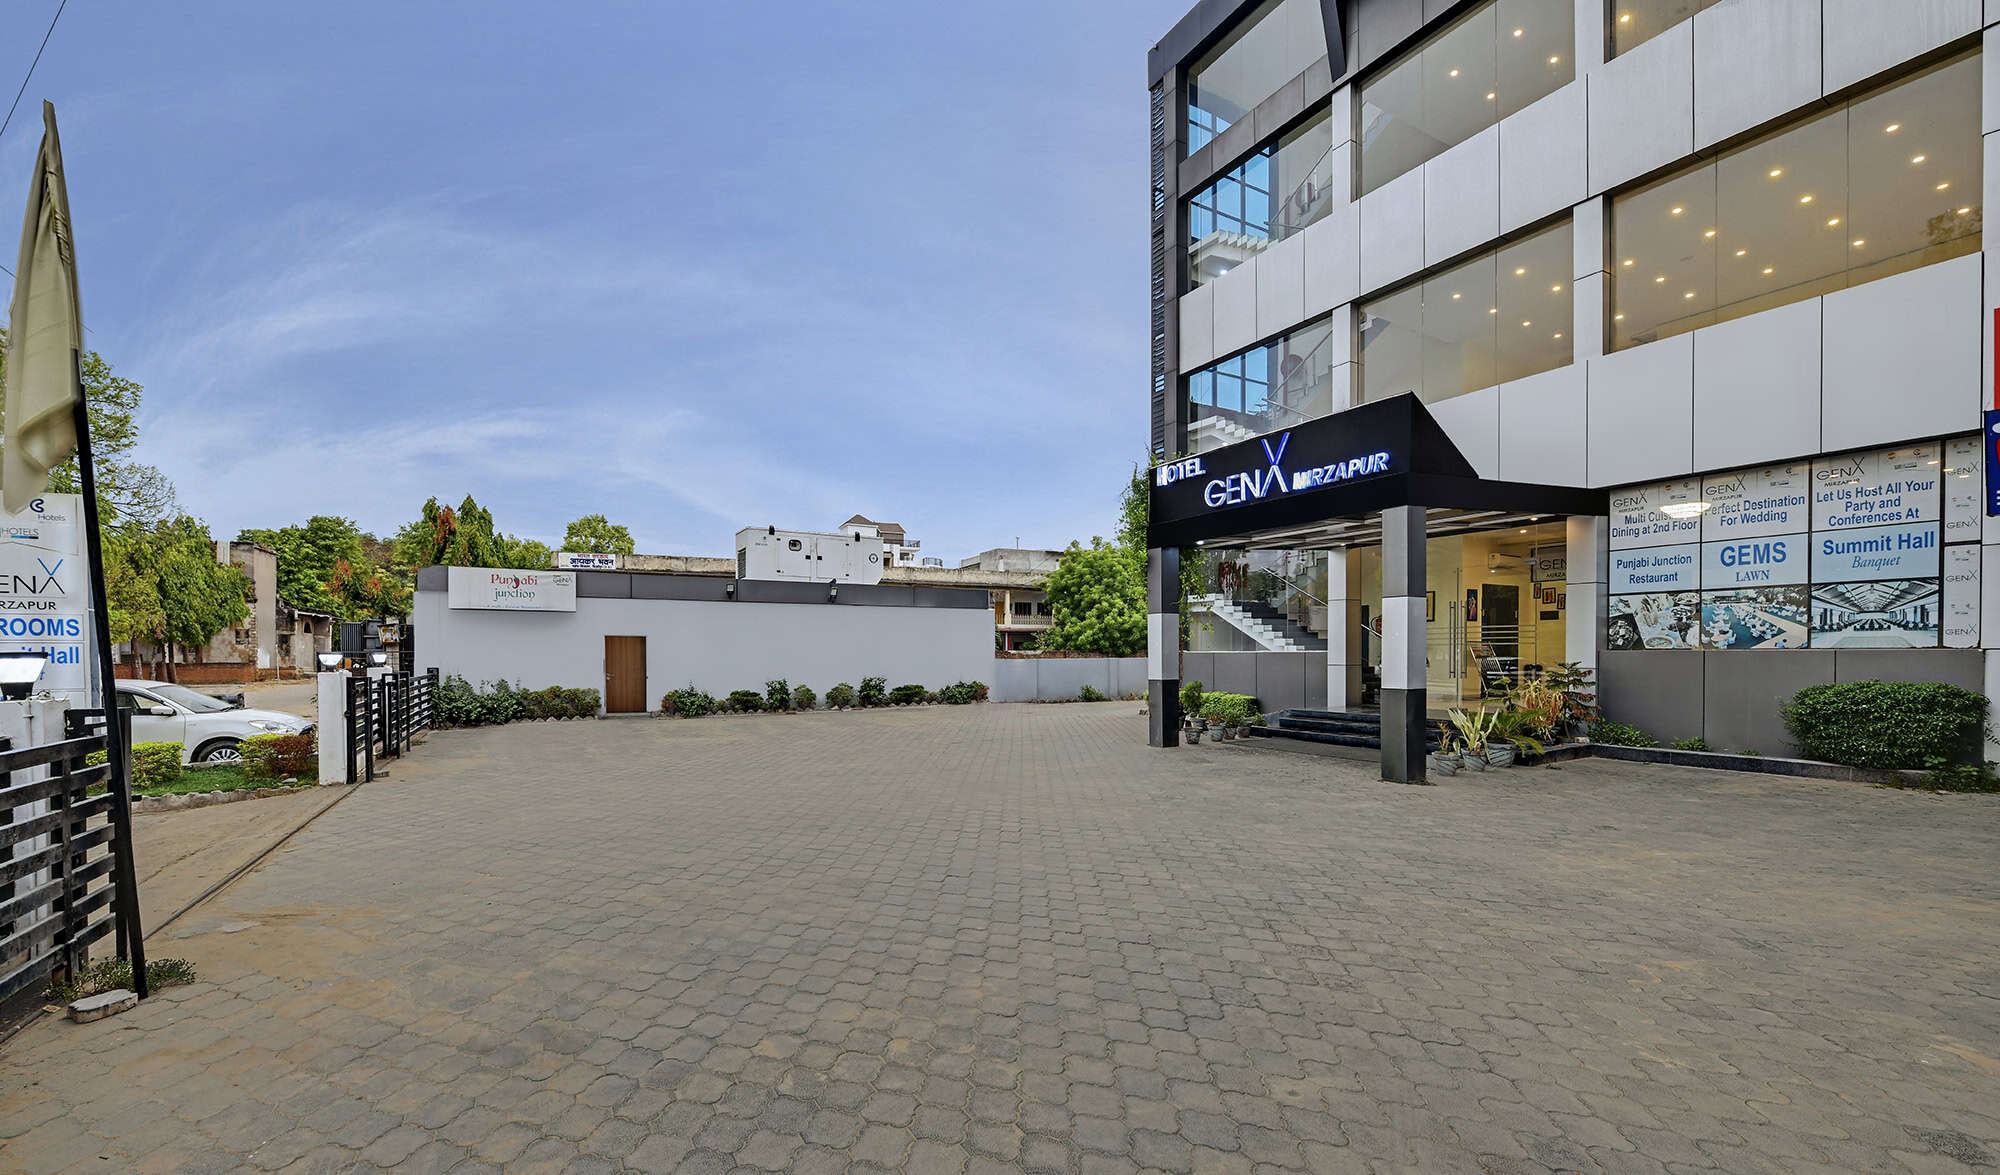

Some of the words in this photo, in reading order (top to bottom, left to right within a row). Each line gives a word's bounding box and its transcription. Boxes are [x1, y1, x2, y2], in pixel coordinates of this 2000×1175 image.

[1156, 457, 1207, 487] HOTEL
[1204, 432, 1290, 508] GENX
[1292, 451, 1391, 491] MIRZAPUR
[1816, 490, 1834, 503] Let
[1836, 489, 1852, 500] Us
[1855, 485, 1883, 498] Host
[1885, 482, 1902, 495] All
[1905, 480, 1935, 492] Your
[1705, 501, 1741, 516] erfect
[1743, 495, 1806, 512] Destination
[1845, 500, 1876, 513] Party
[1878, 496, 1902, 509] and
[37, 514, 67, 522] Hotels
[1624, 512, 1646, 525] Multi
[1720, 516, 1738, 526] For
[1740, 510, 1788, 523] Wedding
[1828, 511, 1903, 527] Conferences
[1905, 507, 1920, 520] At
[1611, 527, 1640, 538] Dining
[1641, 526, 1651, 535] at
[1653, 520, 1670, 534] 2nd
[1672, 520, 1698, 531] Floor
[1822, 535, 1893, 556] Summit
[1897, 530, 1935, 551] Hall
[1616, 556, 1650, 570] Punjabi
[1651, 553, 1693, 568] Junction
[1720, 541, 1787, 567] GEMS
[1540, 558, 1568, 570] GEN
[1851, 555, 1903, 571] Banquet
[490, 573, 538, 589] Punjabi
[1629, 571, 1679, 585] Restaurant
[1735, 569, 1770, 582] LAWN
[493, 587, 536, 602] junction
